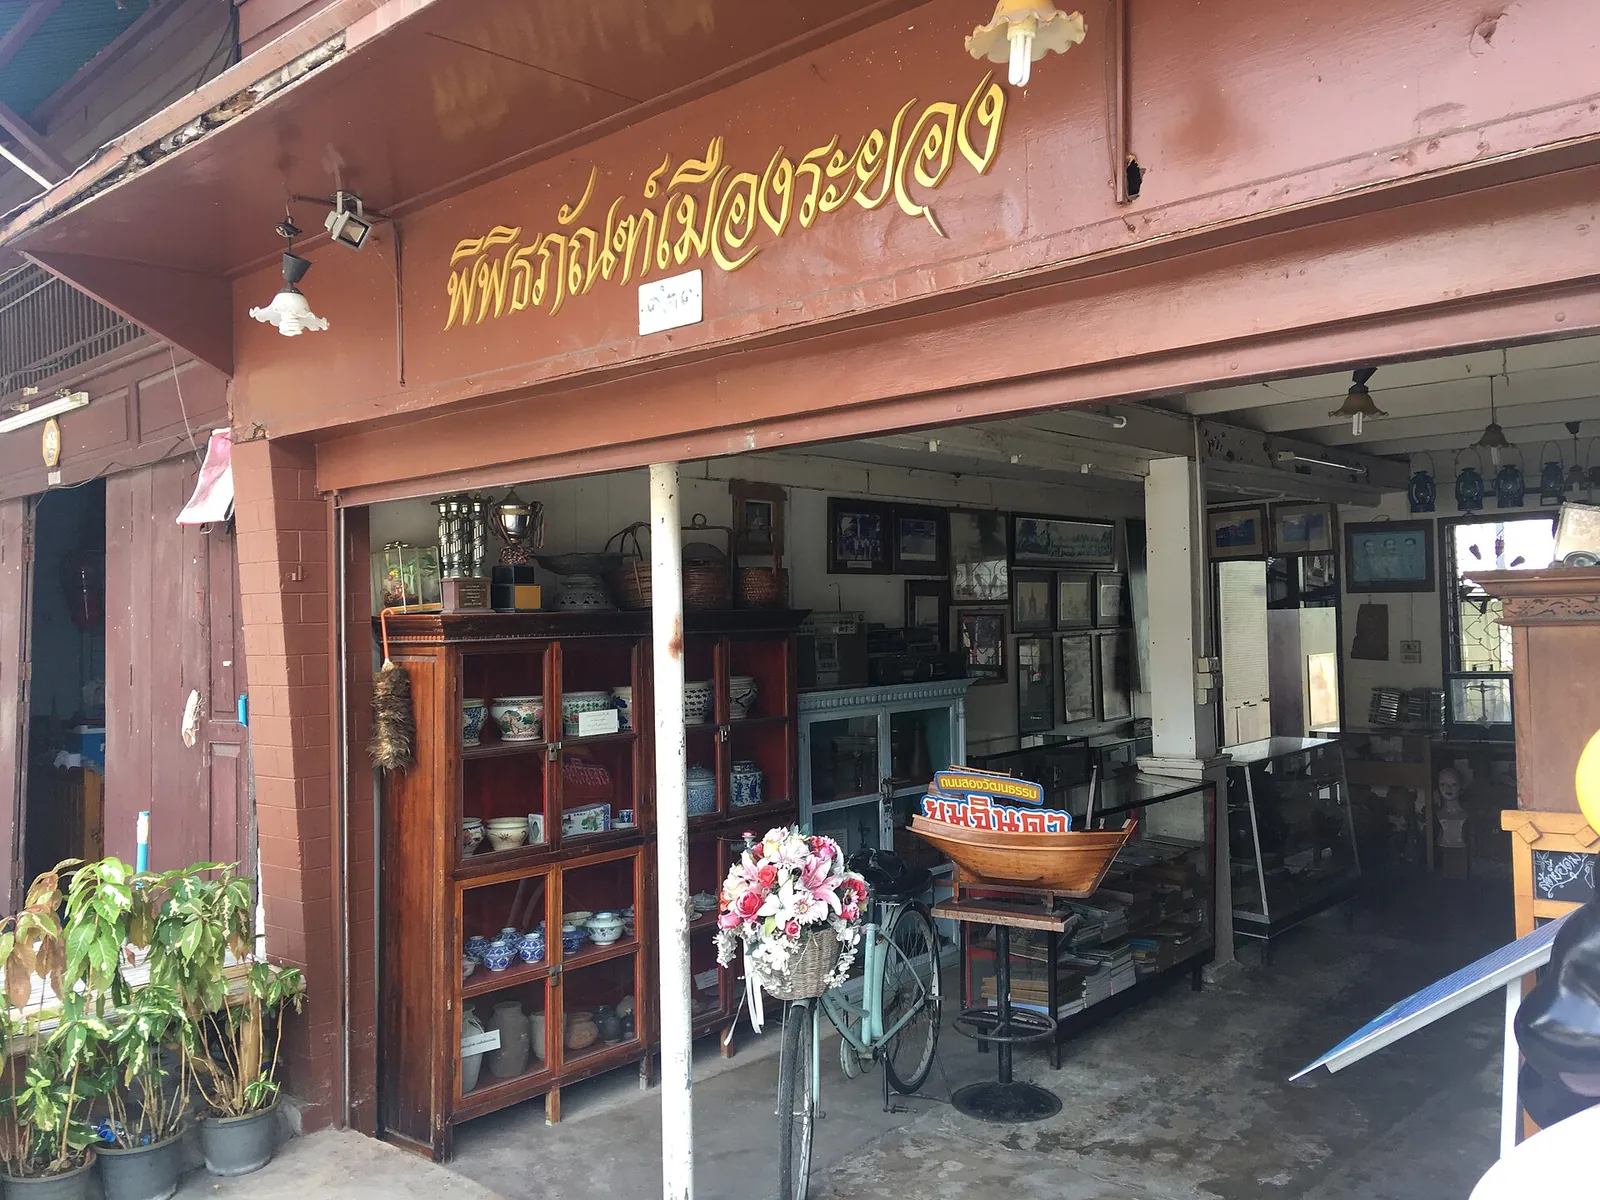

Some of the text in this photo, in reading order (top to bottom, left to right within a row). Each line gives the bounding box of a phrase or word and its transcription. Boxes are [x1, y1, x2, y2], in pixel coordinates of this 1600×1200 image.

[444, 70, 1006, 331] พิพิธภัณฑ์เมืองระยอง
[940, 776, 1038, 800] ถนนสองวัฒนธรรม
[925, 797, 1066, 833] ยมจินดา
